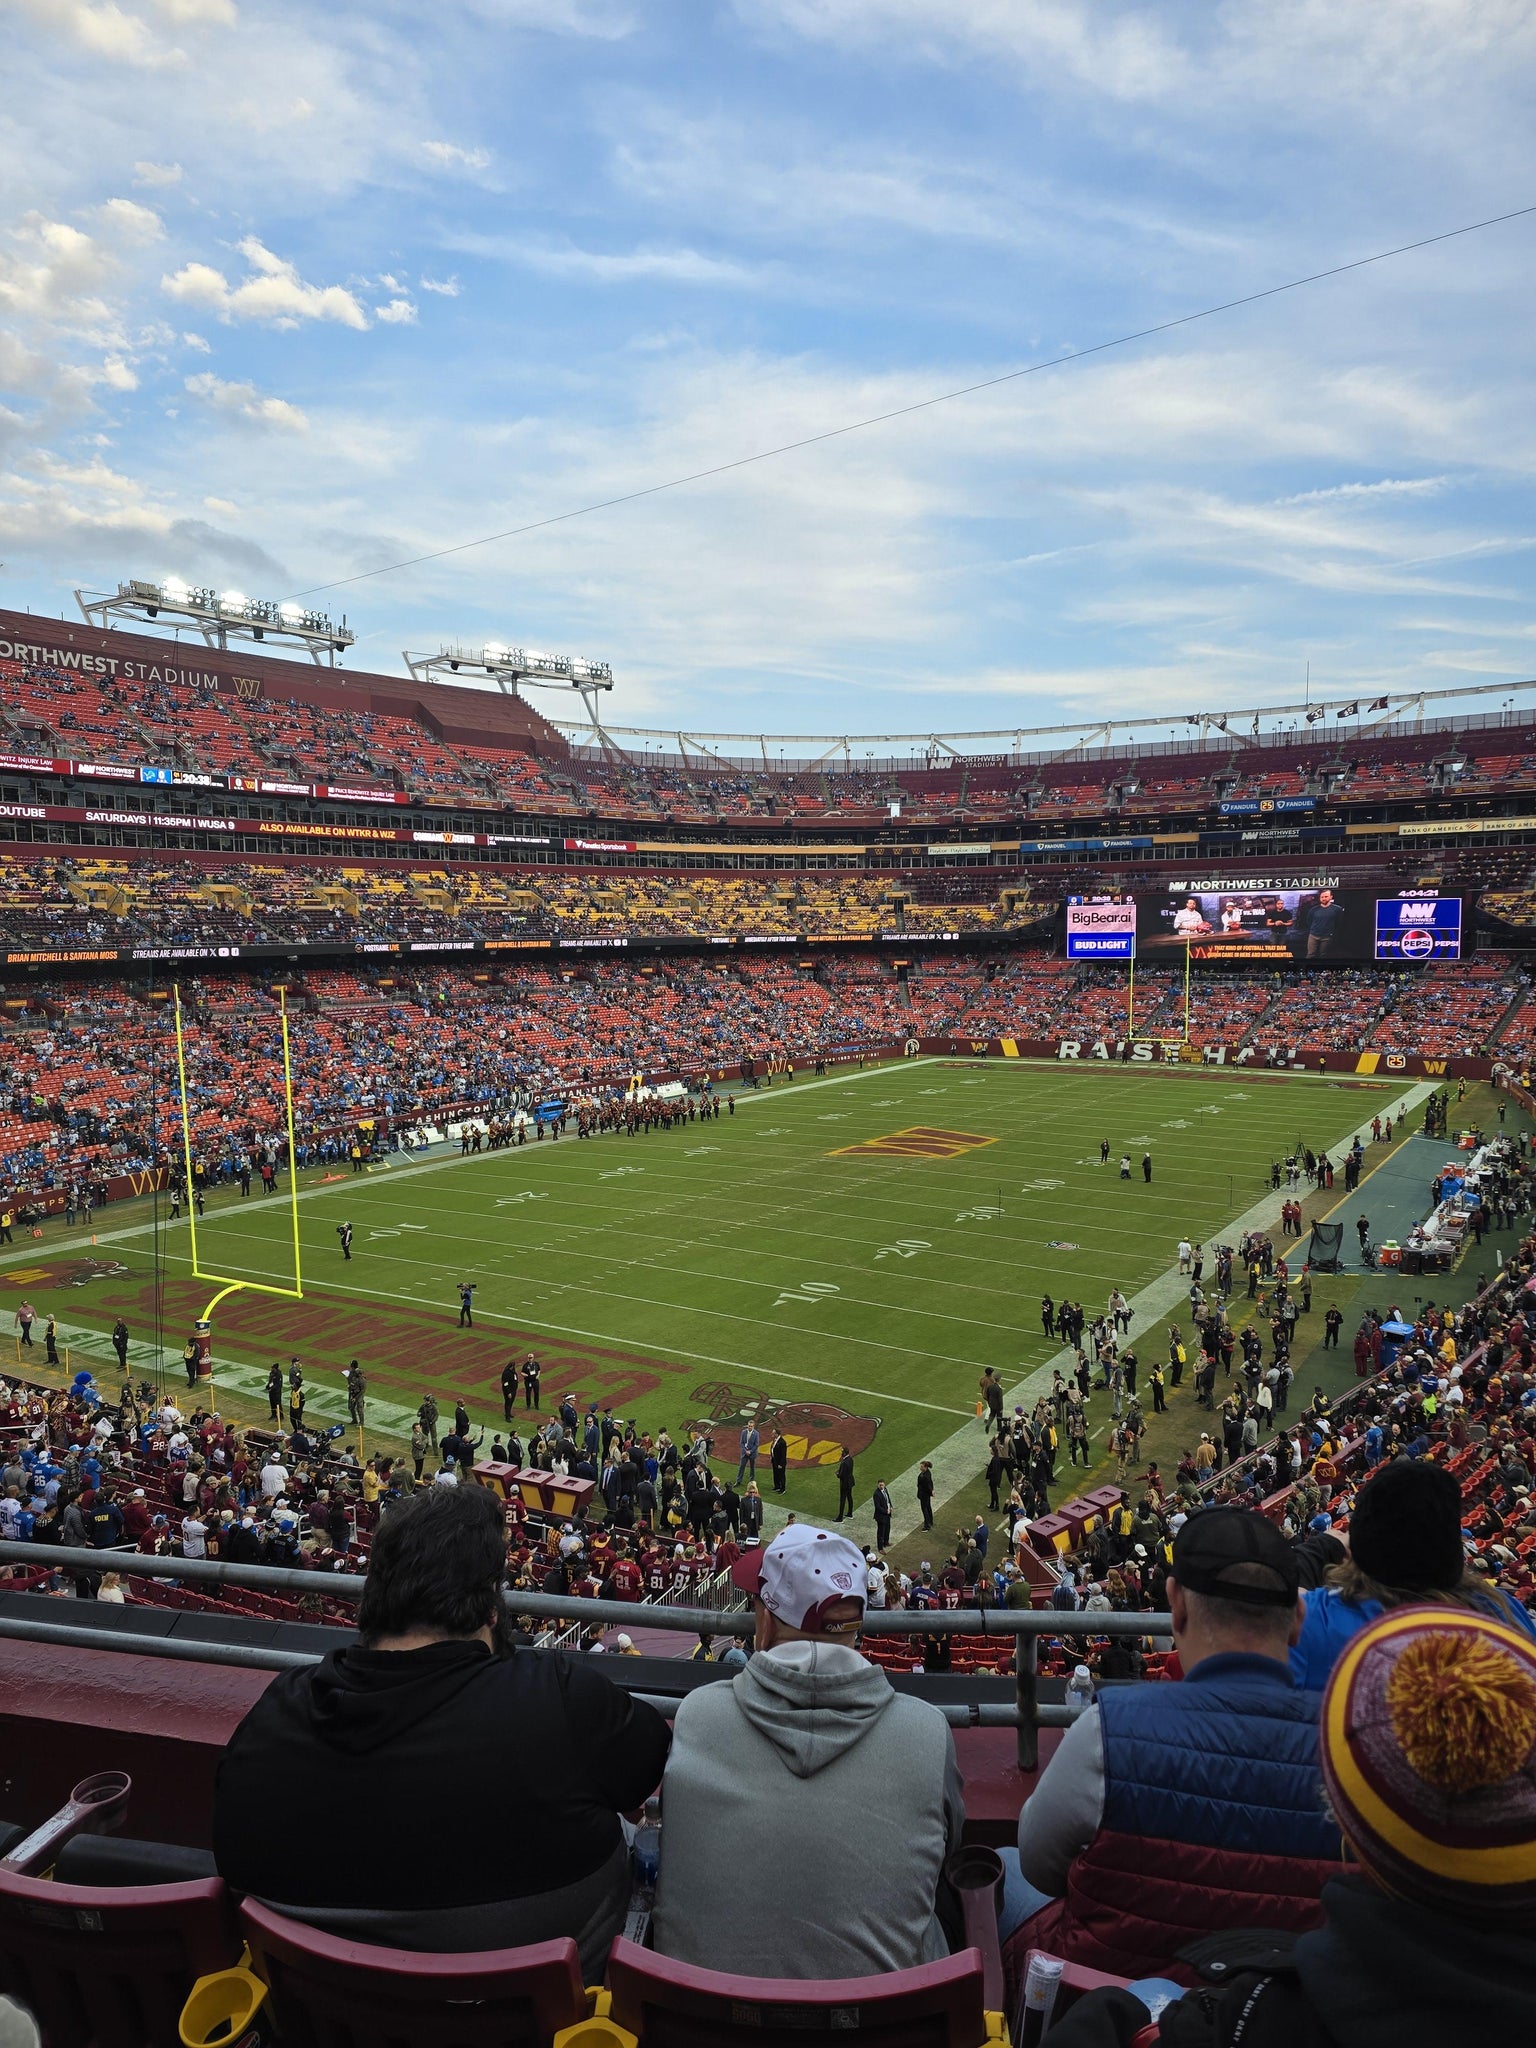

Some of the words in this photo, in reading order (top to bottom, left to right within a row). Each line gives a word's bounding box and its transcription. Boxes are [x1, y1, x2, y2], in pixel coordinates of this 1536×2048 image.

[124, 661, 218, 690] STADIUM
[955, 755, 1006, 763] NORTHWEST
[1230, 803, 1257, 811] FANDUEL
[1261, 802, 1273, 810] 25
[86, 812, 146, 823] SATURDAYS
[154, 816, 191, 827] 11:35PM
[198, 820, 227, 829] WUSA
[228, 822, 235, 830] 9
[259, 823, 284, 832] ALSO
[285, 825, 331, 836] AVAILABLE
[333, 828, 346, 836] ON
[371, 830, 379, 838] &
[1190, 878, 1272, 890] NORTHWEST
[1275, 876, 1339, 888] STADIUM
[1398, 889, 1439, 897] 4:04:21
[1400, 903, 1437, 918] NW
[1072, 911, 1131, 926] BigBear.ai
[363, 944, 390, 952] POSTGAME
[1075, 941, 1097, 949] BUD
[1098, 941, 1127, 949] LIGHT
[7, 953, 29, 962] BRIAN
[30, 952, 62, 962] MITCHELL
[63, 952, 68, 961] &
[69, 952, 99, 961] SANTANA
[100, 951, 118, 960] MOSS
[132, 950, 159, 959] STREAMS
[159, 950, 170, 958] ARE
[171, 949, 199, 958] AVAILABLE
[200, 948, 208, 957] ON
[956, 1206, 1006, 1221] 30
[876, 1239, 933, 1259] 20
[1390, 1252, 1399, 1261] G
[779, 1281, 841, 1304] 10
[151, 1441, 166, 1451] 28
[34, 1474, 46, 1487] 26
[505, 1510, 518, 1524] 21
[206, 1540, 220, 1555] 10
[597, 1561, 605, 1575] 7
[615, 1574, 631, 1591] 21
[650, 1576, 664, 1589] 81
[945, 1597, 959, 1610] 17
